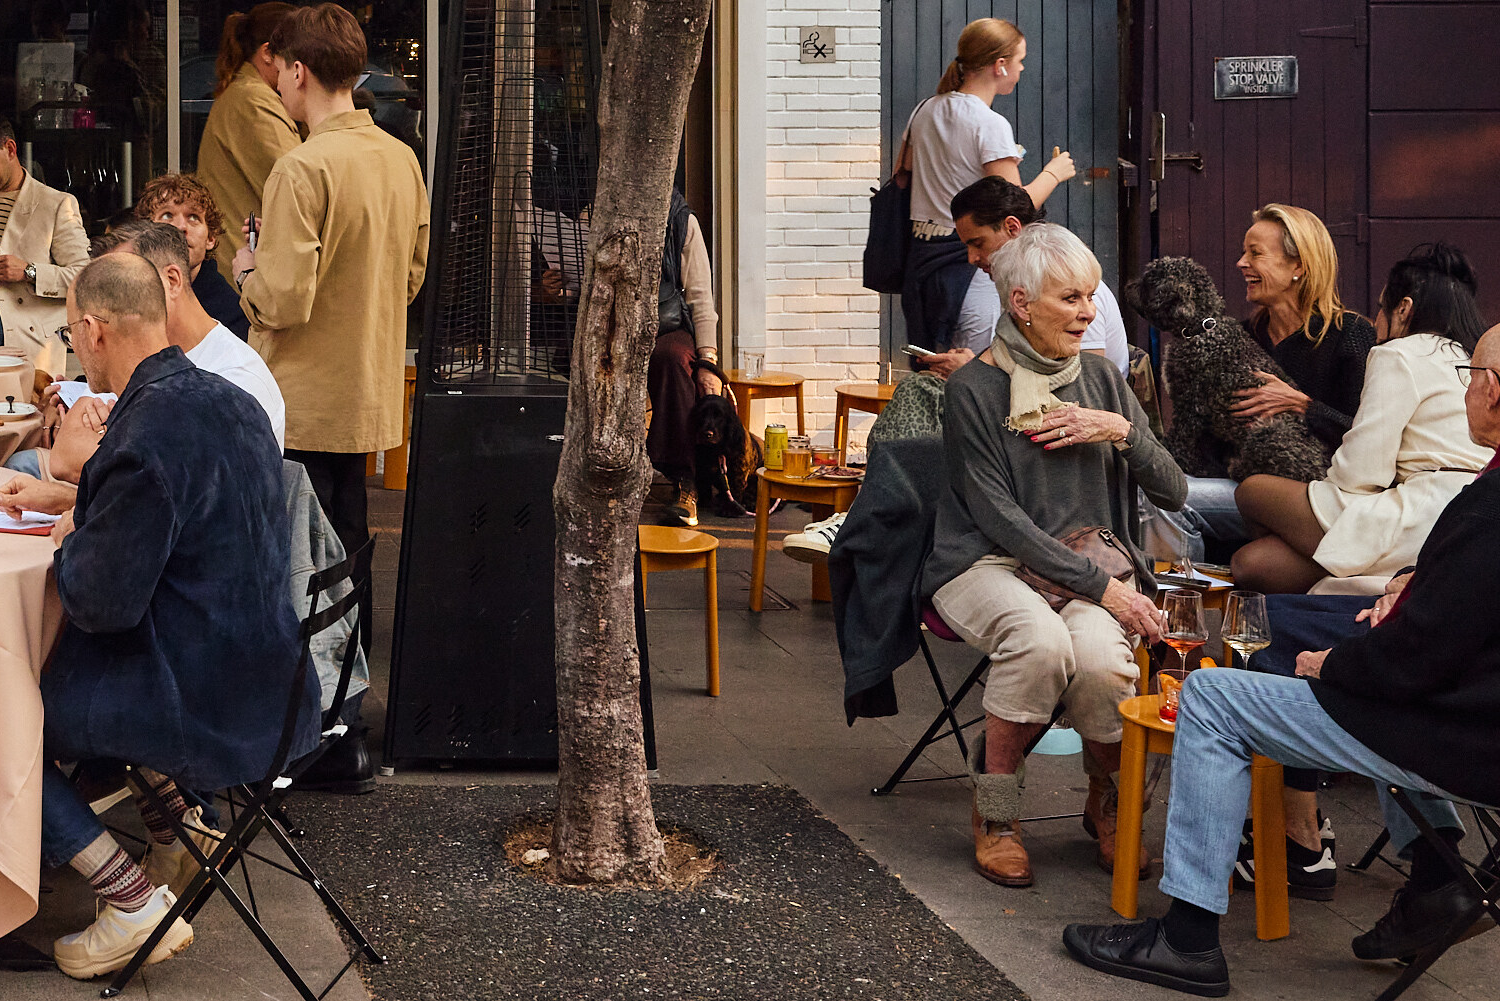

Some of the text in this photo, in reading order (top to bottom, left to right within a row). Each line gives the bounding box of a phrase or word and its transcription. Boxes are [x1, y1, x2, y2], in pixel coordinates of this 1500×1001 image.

[1228, 60, 1284, 73] SPRINKLER
[1228, 74, 1284, 86] STOP VALVE
[1244, 85, 1269, 93] INSIDE
